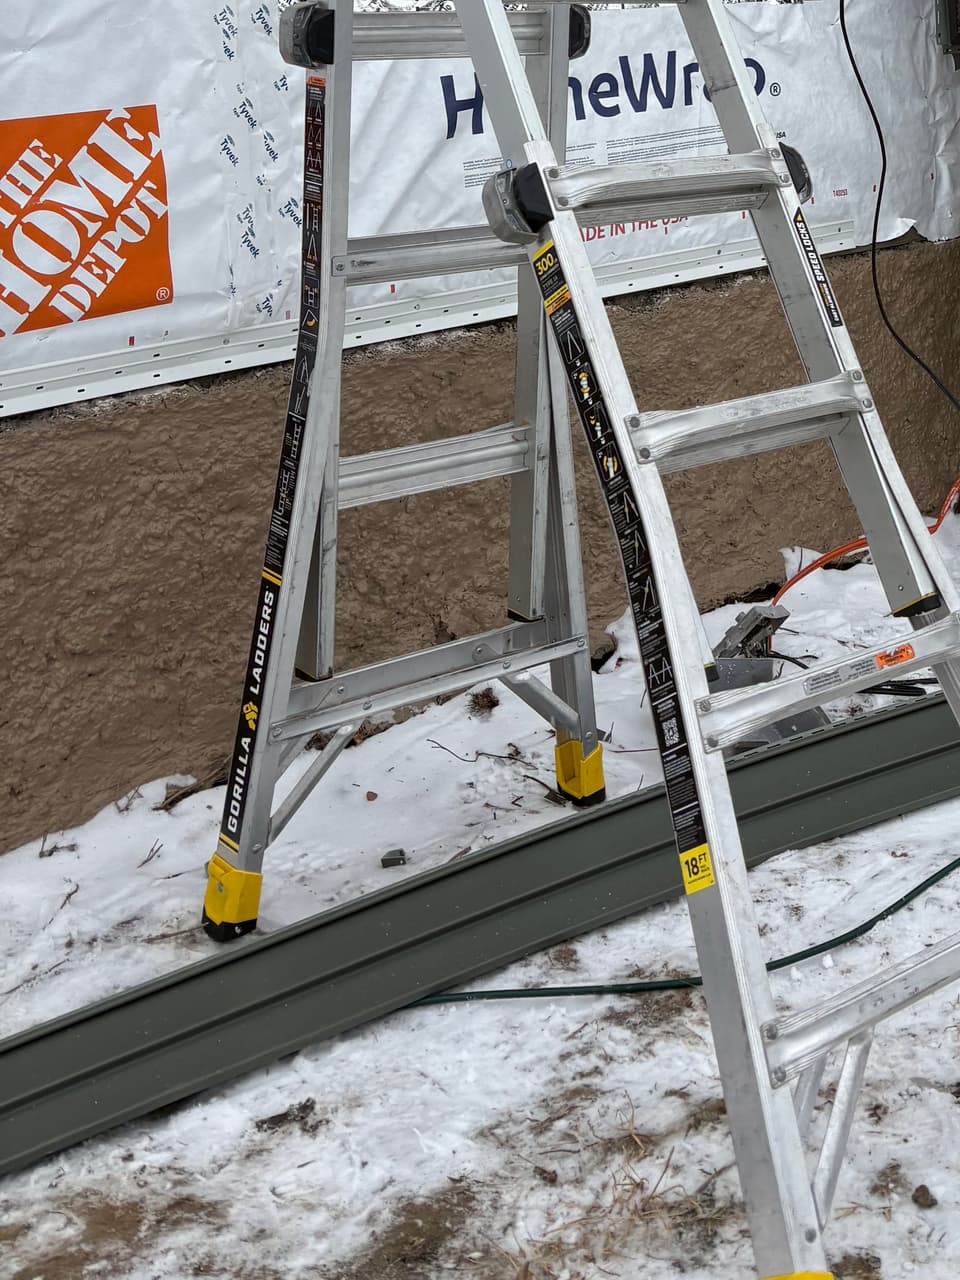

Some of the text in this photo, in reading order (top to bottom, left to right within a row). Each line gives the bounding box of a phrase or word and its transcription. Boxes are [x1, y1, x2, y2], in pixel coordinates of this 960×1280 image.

[219, 9, 238, 37] Tyvek
[255, 8, 273, 37] Tyvek
[239, 101, 257, 129] Tyvek
[220, 138, 239, 167] Tyvek
[284, 201, 303, 228] Tyvek
[48, 181, 168, 321] DEPOT
[241, 231, 259, 258] Tyvek
[797, 222, 825, 282] SPEED LOCKS
[536, 253, 554, 276] 300
[227, 589, 275, 836] GORILLA LADDERS
[684, 856, 700, 878] 18
[698, 852, 707, 865] FT
